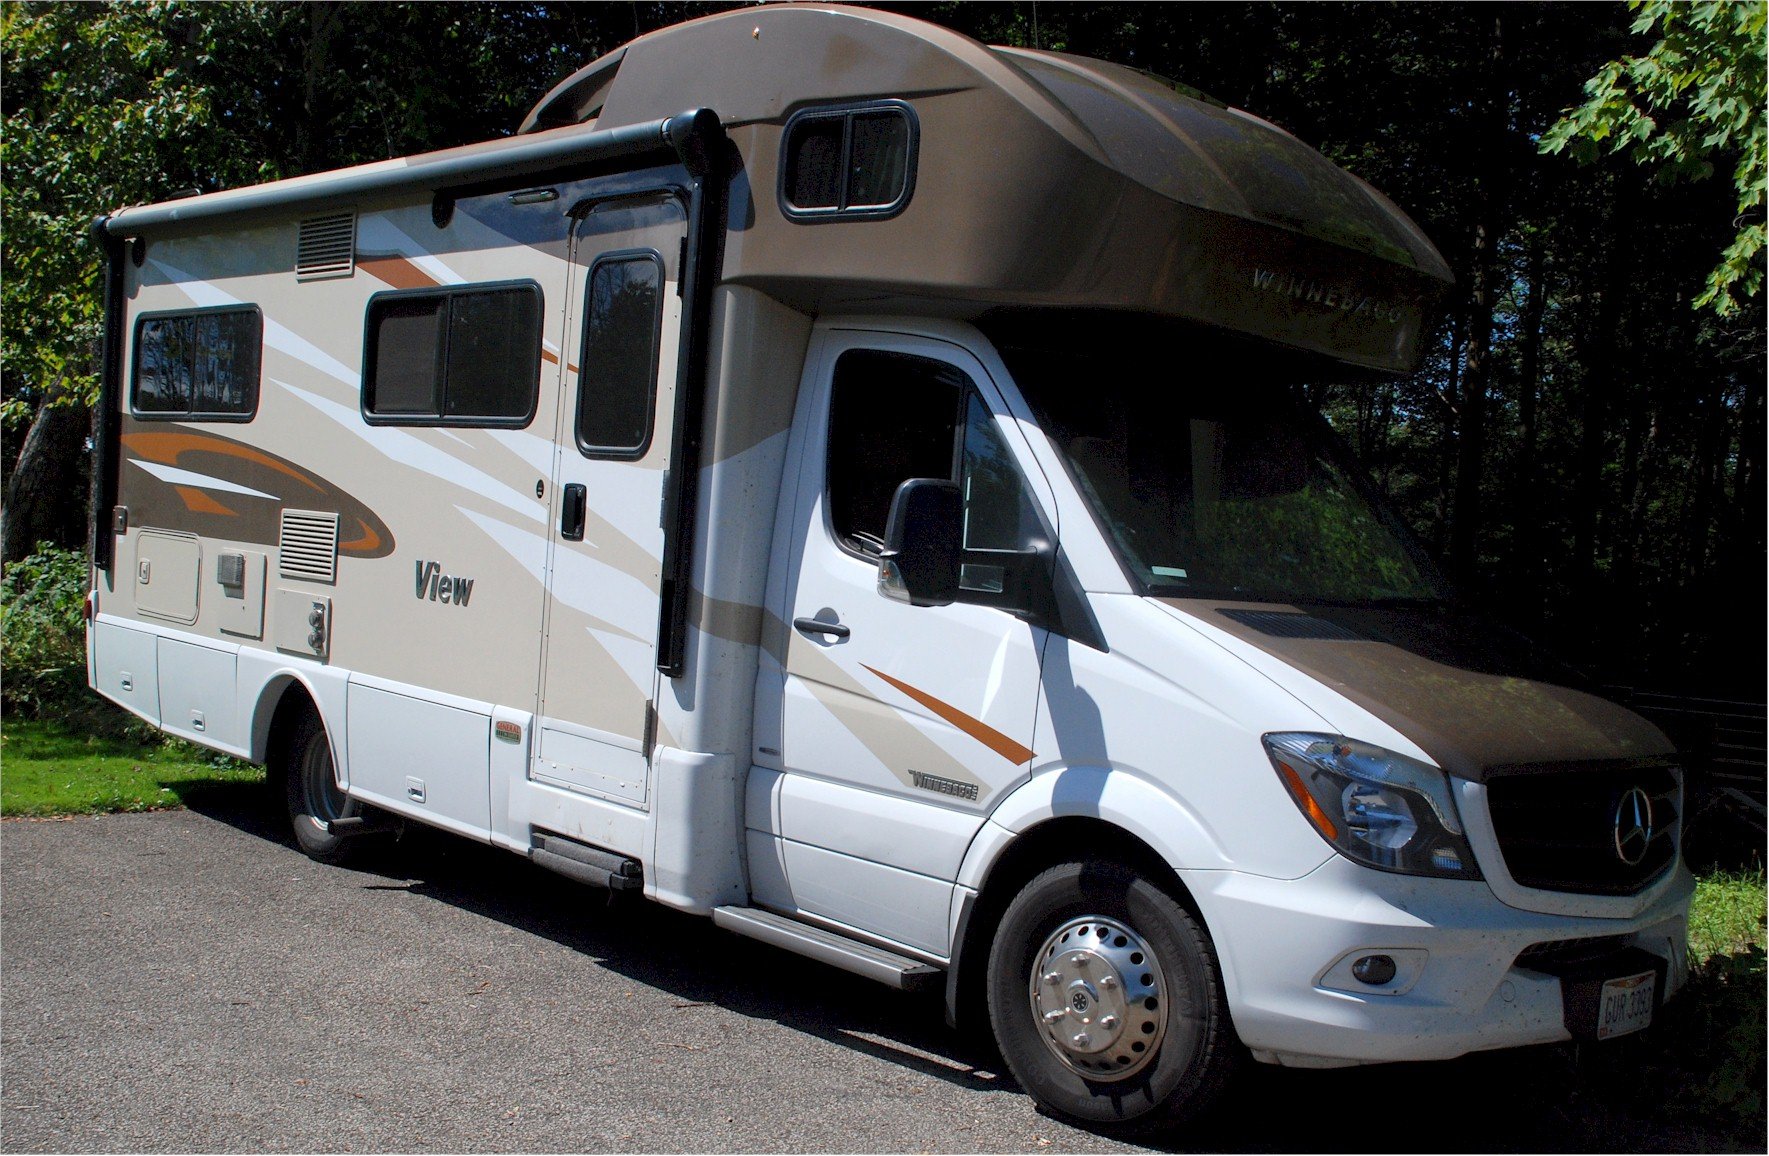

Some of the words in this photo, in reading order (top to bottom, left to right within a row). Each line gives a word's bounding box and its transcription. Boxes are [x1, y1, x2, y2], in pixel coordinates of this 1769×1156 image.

[1253, 268, 1401, 324] WINNEBAGO
[415, 560, 474, 607] View
[908, 769, 972, 799] WINNEBAGO
[1605, 993, 1627, 1024] GUR
